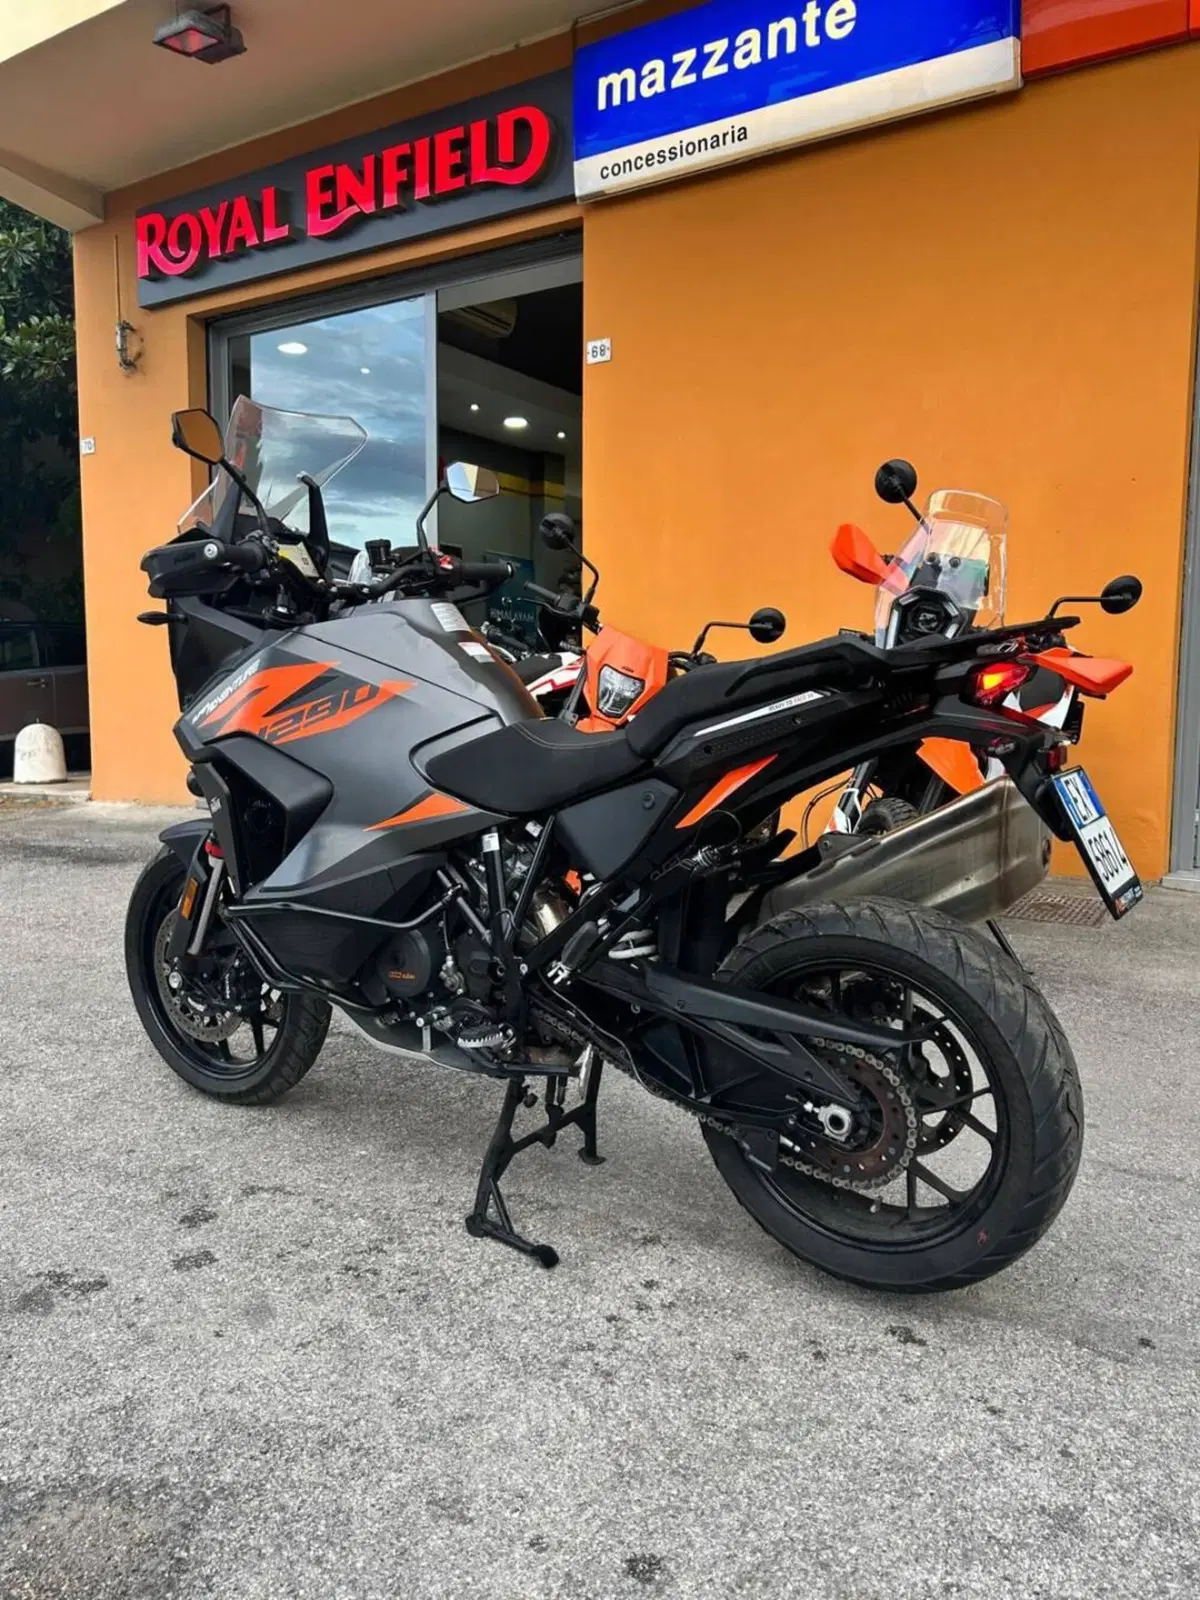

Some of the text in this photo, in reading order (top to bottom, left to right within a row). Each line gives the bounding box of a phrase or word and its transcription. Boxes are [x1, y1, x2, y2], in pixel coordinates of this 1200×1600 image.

[597, 0, 857, 112] mazzante
[136, 105, 551, 280] ROYAL ENFIELD
[599, 125, 748, 180] concessionaria
